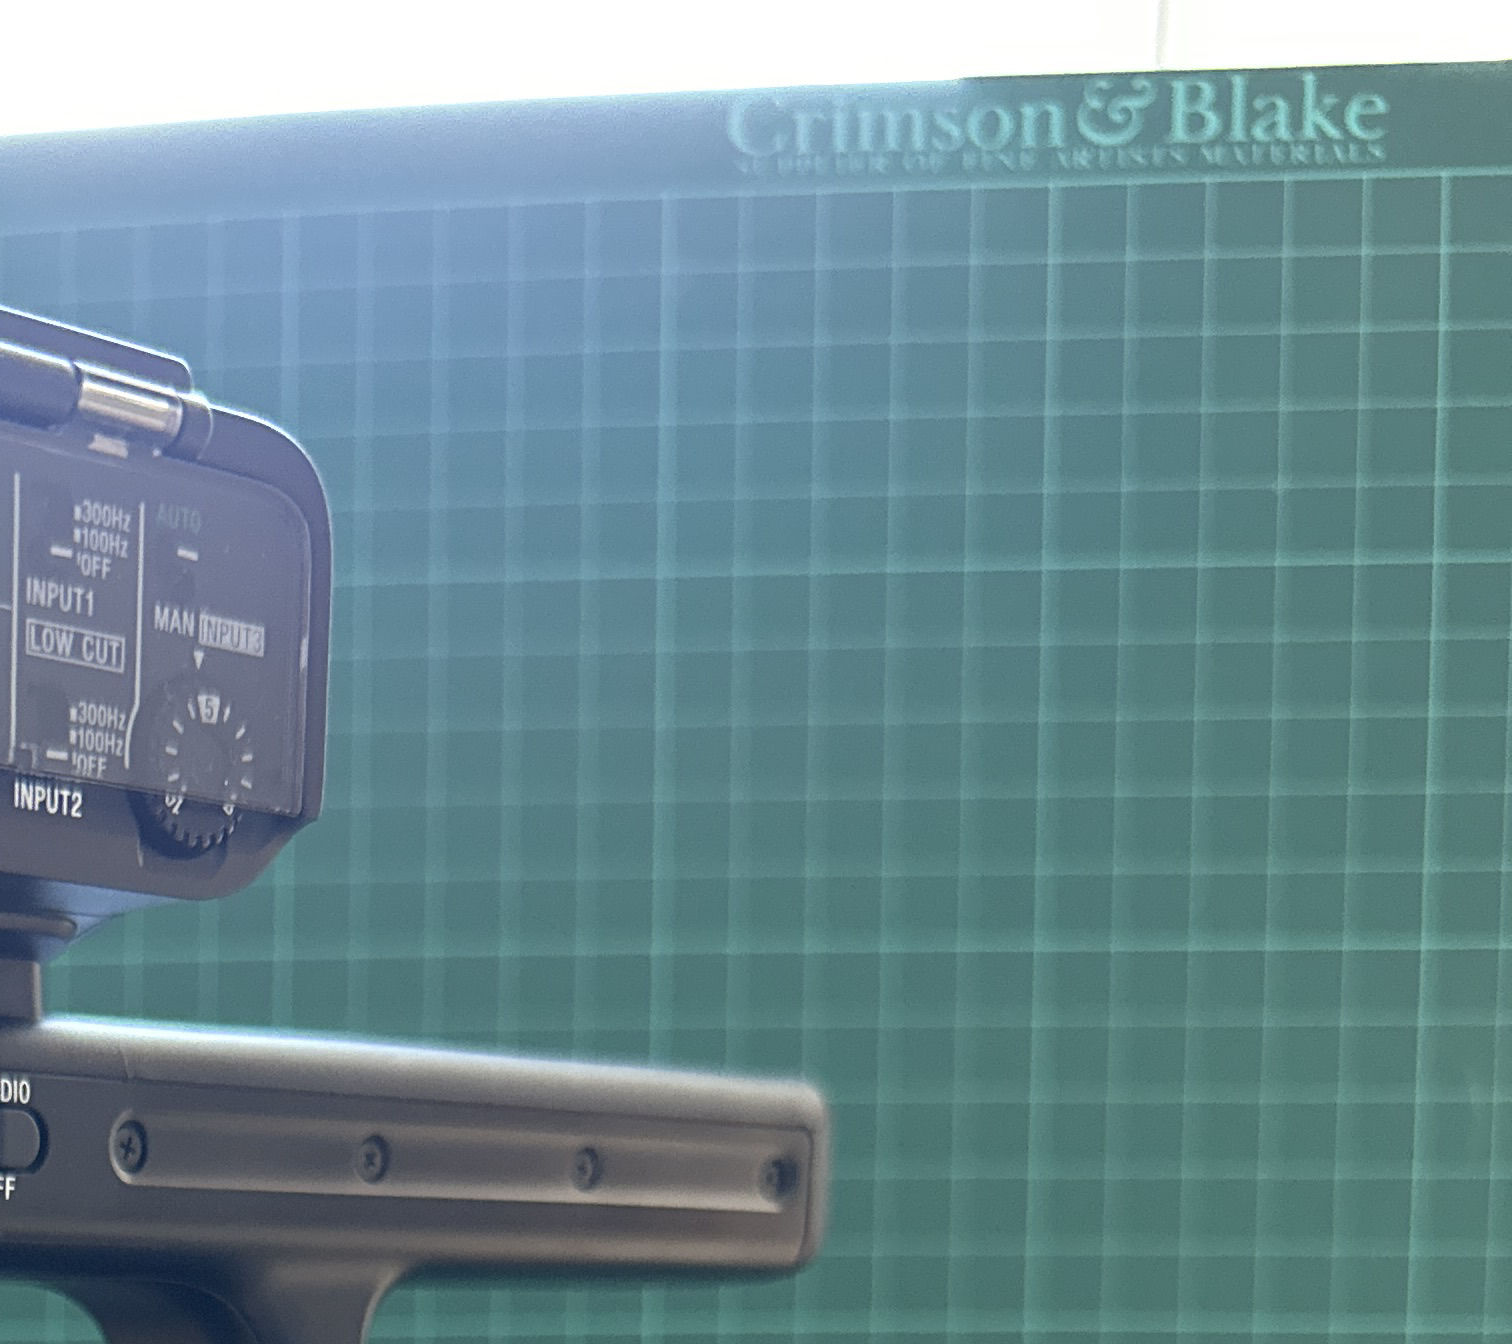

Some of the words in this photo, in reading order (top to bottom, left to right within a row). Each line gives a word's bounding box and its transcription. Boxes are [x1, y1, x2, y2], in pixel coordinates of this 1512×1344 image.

[82, 500, 131, 532] 300Hz
[83, 529, 128, 559] 100Hz
[26, 577, 94, 617] INPUT1
[154, 602, 195, 637] MAN
[30, 625, 73, 657] LOW
[82, 635, 120, 667] CUT
[78, 702, 126, 731] 300Hz
[79, 731, 123, 757] 100Hz
[13, 781, 83, 818] INPUT2
